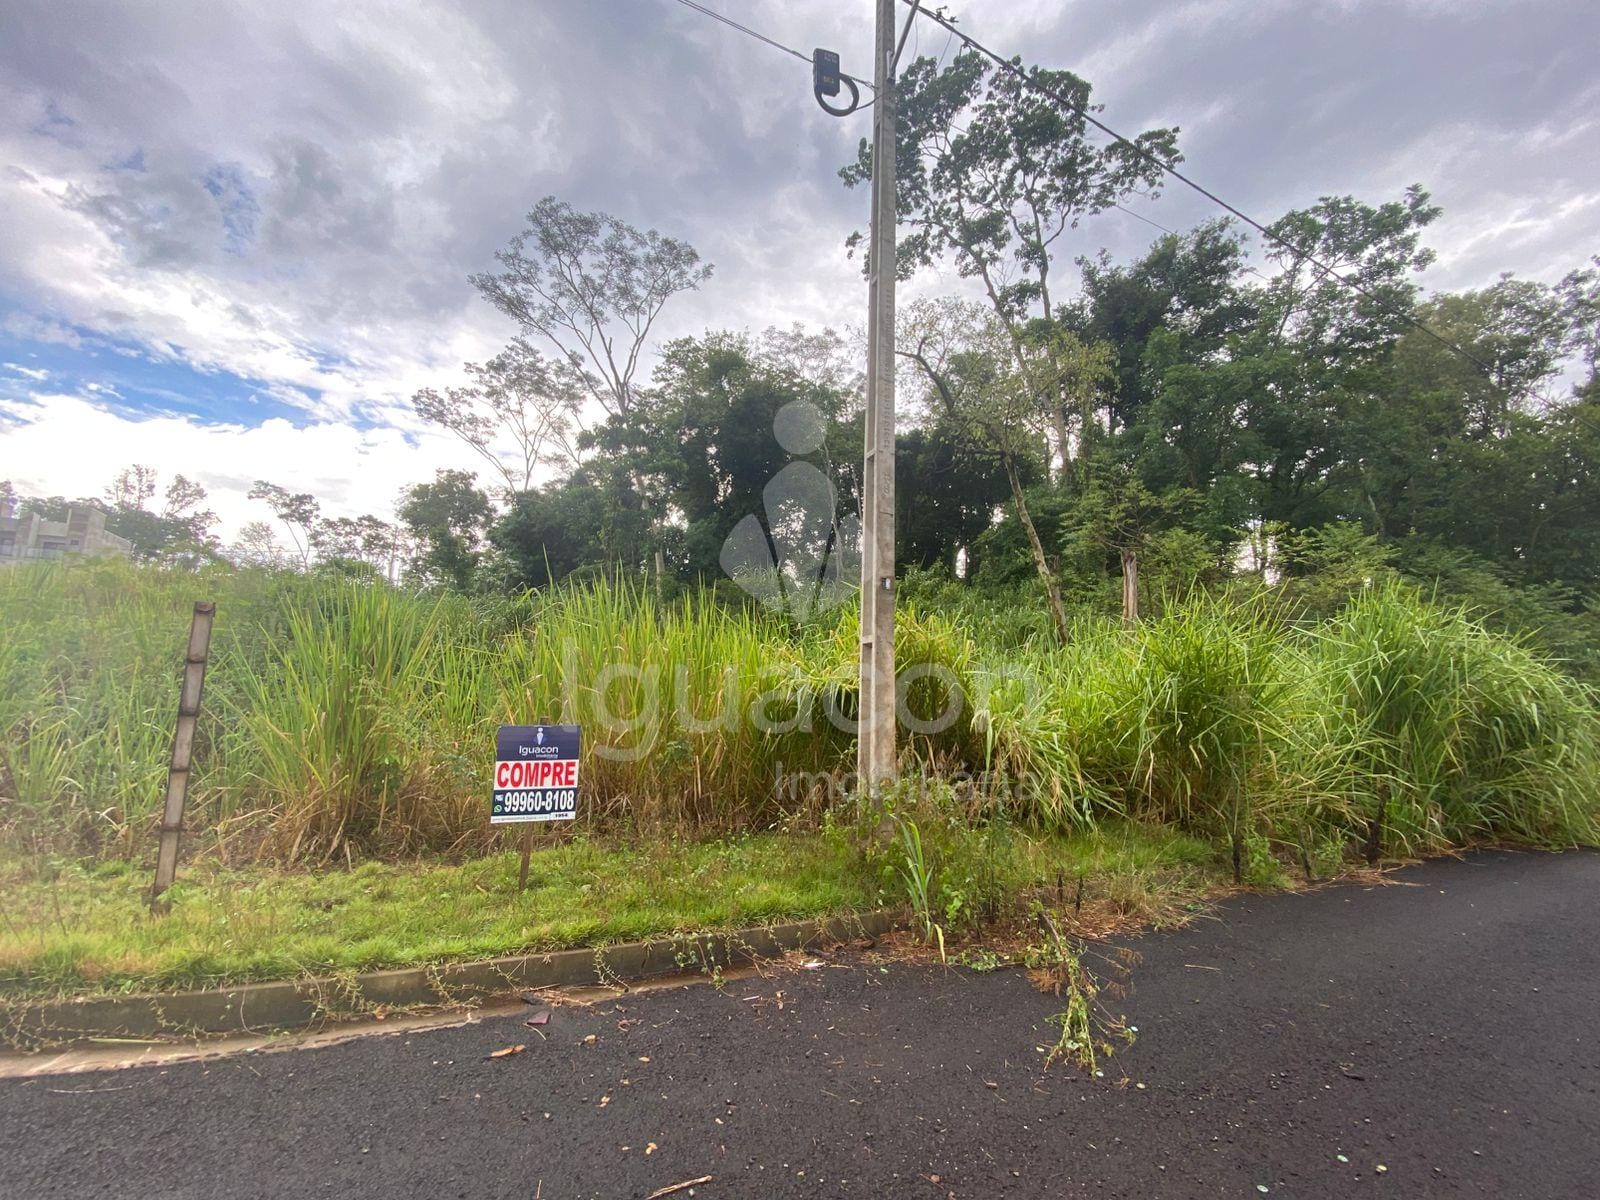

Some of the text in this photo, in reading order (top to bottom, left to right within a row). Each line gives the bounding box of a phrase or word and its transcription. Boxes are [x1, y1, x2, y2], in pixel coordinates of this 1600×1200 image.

[519, 745, 559, 756] Iguacon
[497, 762, 576, 788] COMPRE
[504, 790, 574, 812] 99960-8108
